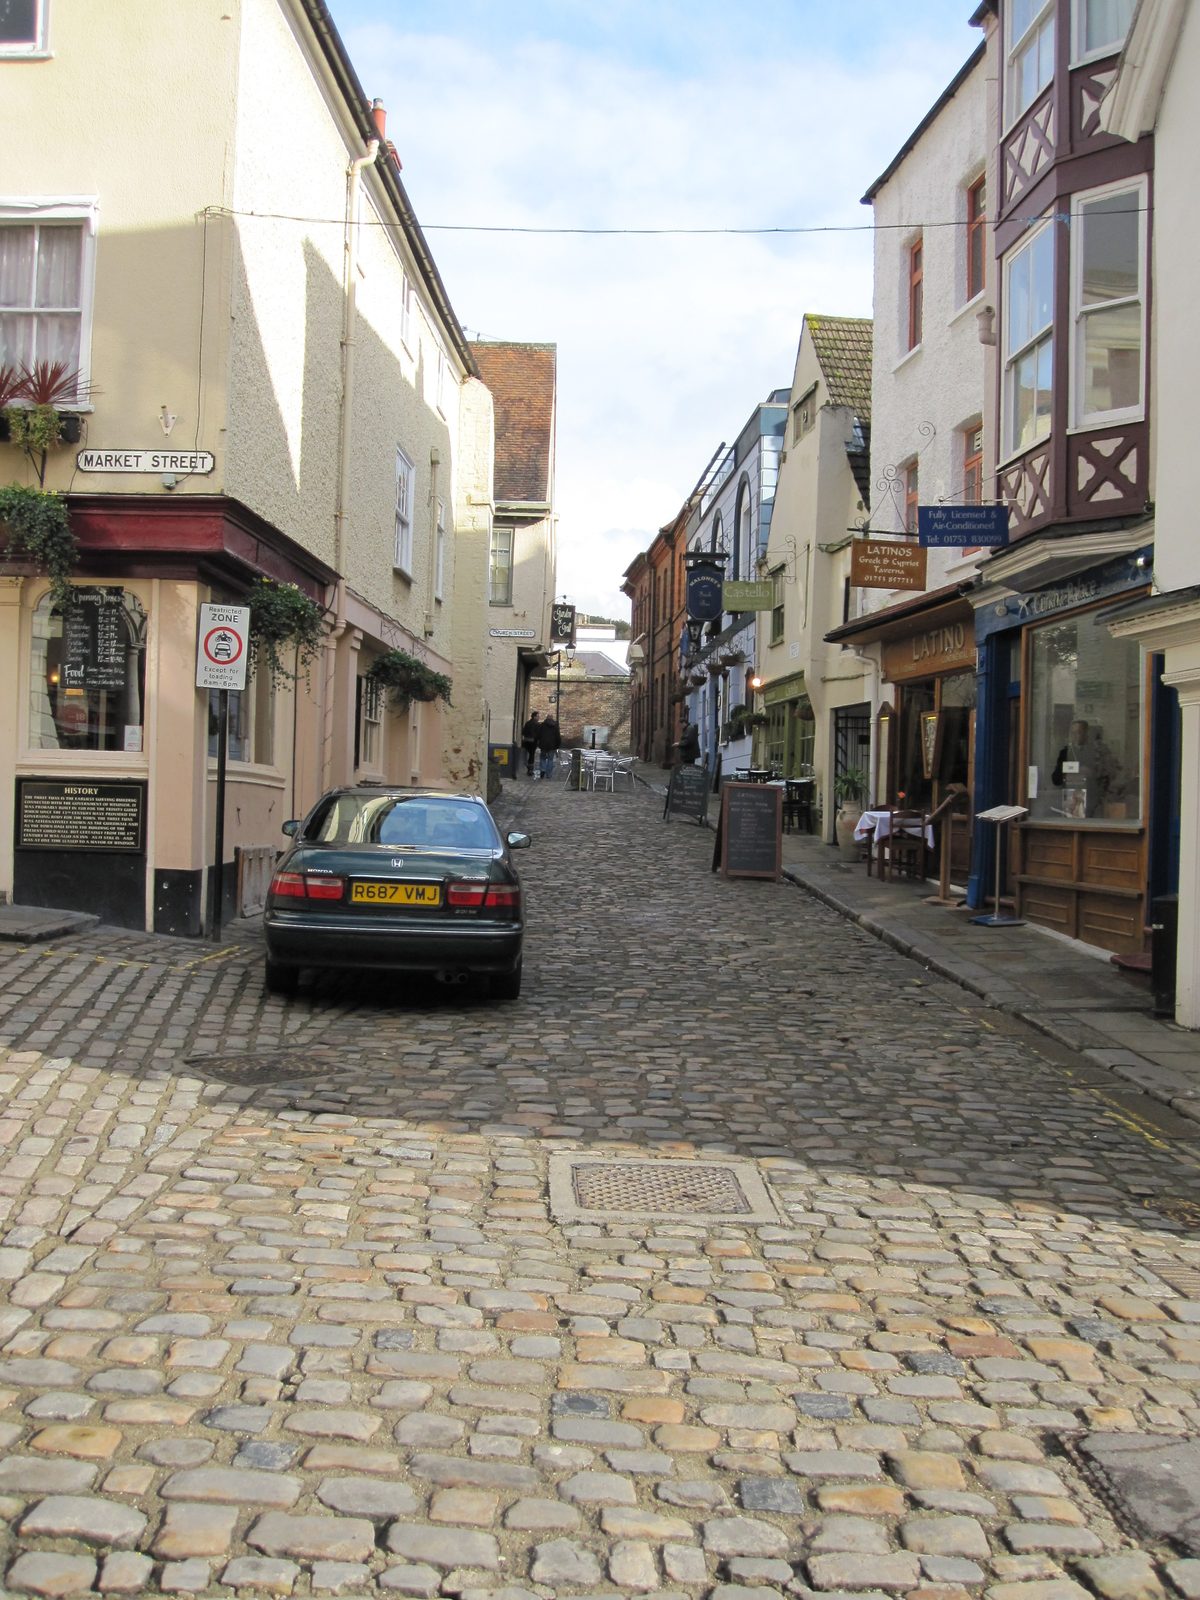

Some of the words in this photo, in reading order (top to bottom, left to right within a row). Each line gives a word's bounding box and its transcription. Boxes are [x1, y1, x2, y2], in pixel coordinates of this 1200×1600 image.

[84, 455, 141, 468] MARKET
[151, 456, 208, 469] STREET
[928, 510, 947, 521] Fully
[951, 510, 986, 519] Licensed
[990, 511, 997, 519] &
[931, 520, 995, 530] Air-Conditioned
[926, 535, 940, 544] Tel:
[943, 535, 967, 544] 01753
[866, 545, 913, 557] LATINOS
[858, 555, 881, 565] Greek
[882, 557, 889, 565] &
[891, 557, 920, 568] Cypriot
[873, 564, 905, 575] Taverna
[724, 584, 770, 598] Castello
[208, 606, 242, 615] Restricted
[211, 614, 239, 623] ZONE
[912, 623, 964, 661] LATINO
[63, 664, 85, 678] Food
[204, 665, 226, 674] Except
[208, 673, 233, 681] loading
[64, 787, 99, 795] HISTORY
[354, 885, 399, 899] R687
[405, 887, 438, 901] VMJ
